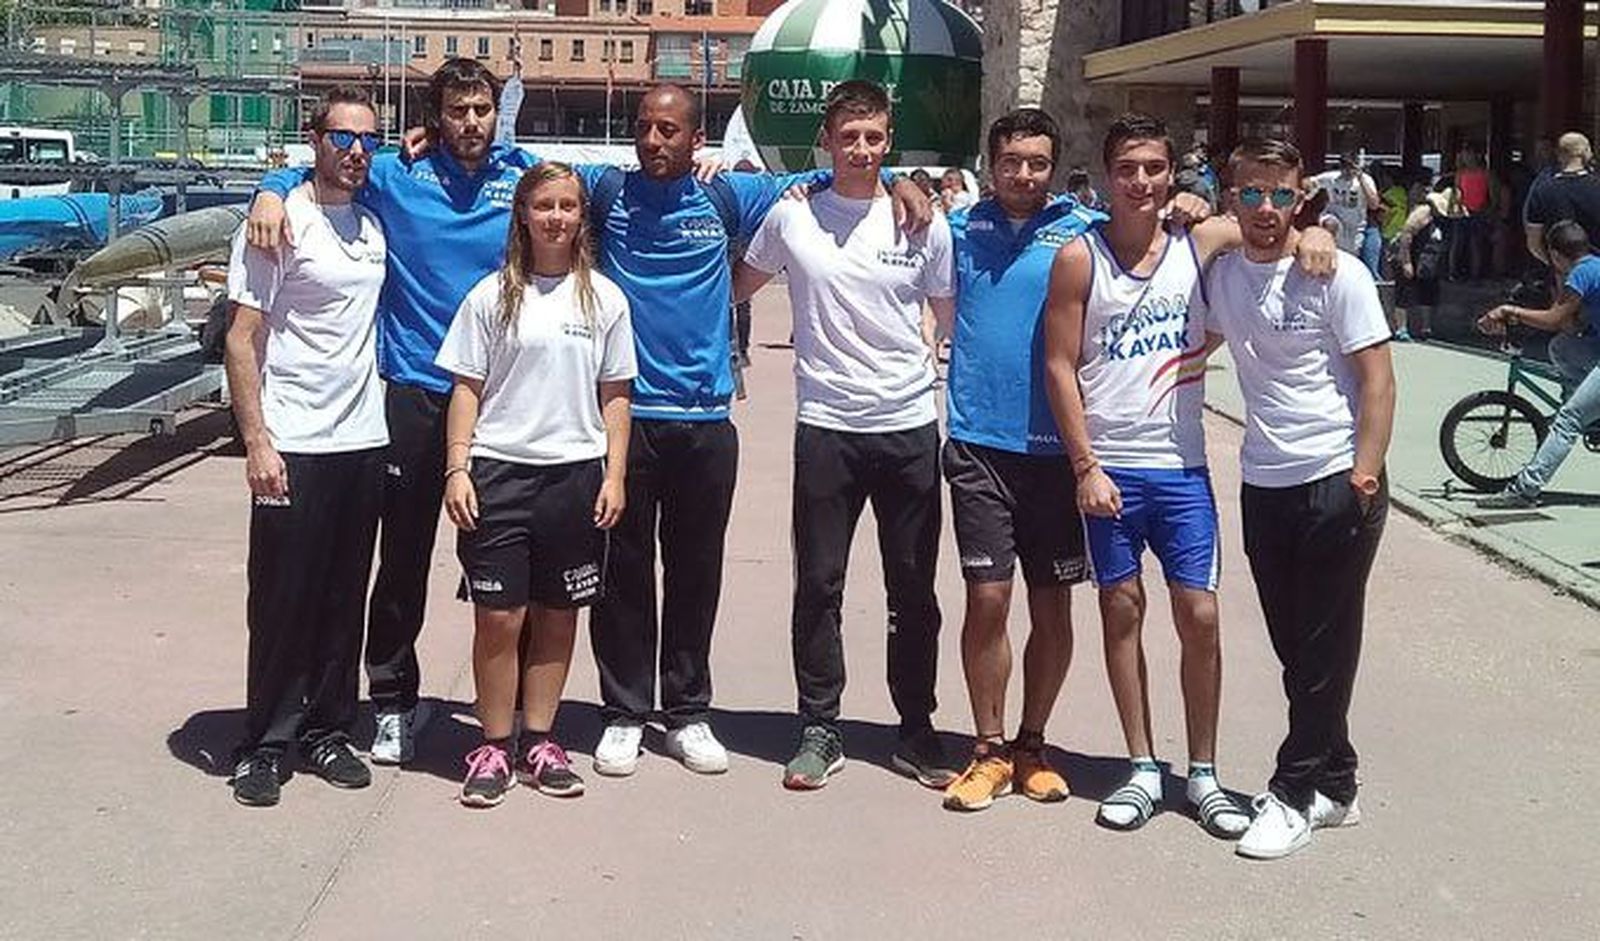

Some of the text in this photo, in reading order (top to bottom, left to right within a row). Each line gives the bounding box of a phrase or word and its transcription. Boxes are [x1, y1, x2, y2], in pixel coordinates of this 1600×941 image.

[768, 79, 815, 99] CAJA
[770, 102, 828, 114] DE ZAMO
[1108, 330, 1191, 361] KAYAK
